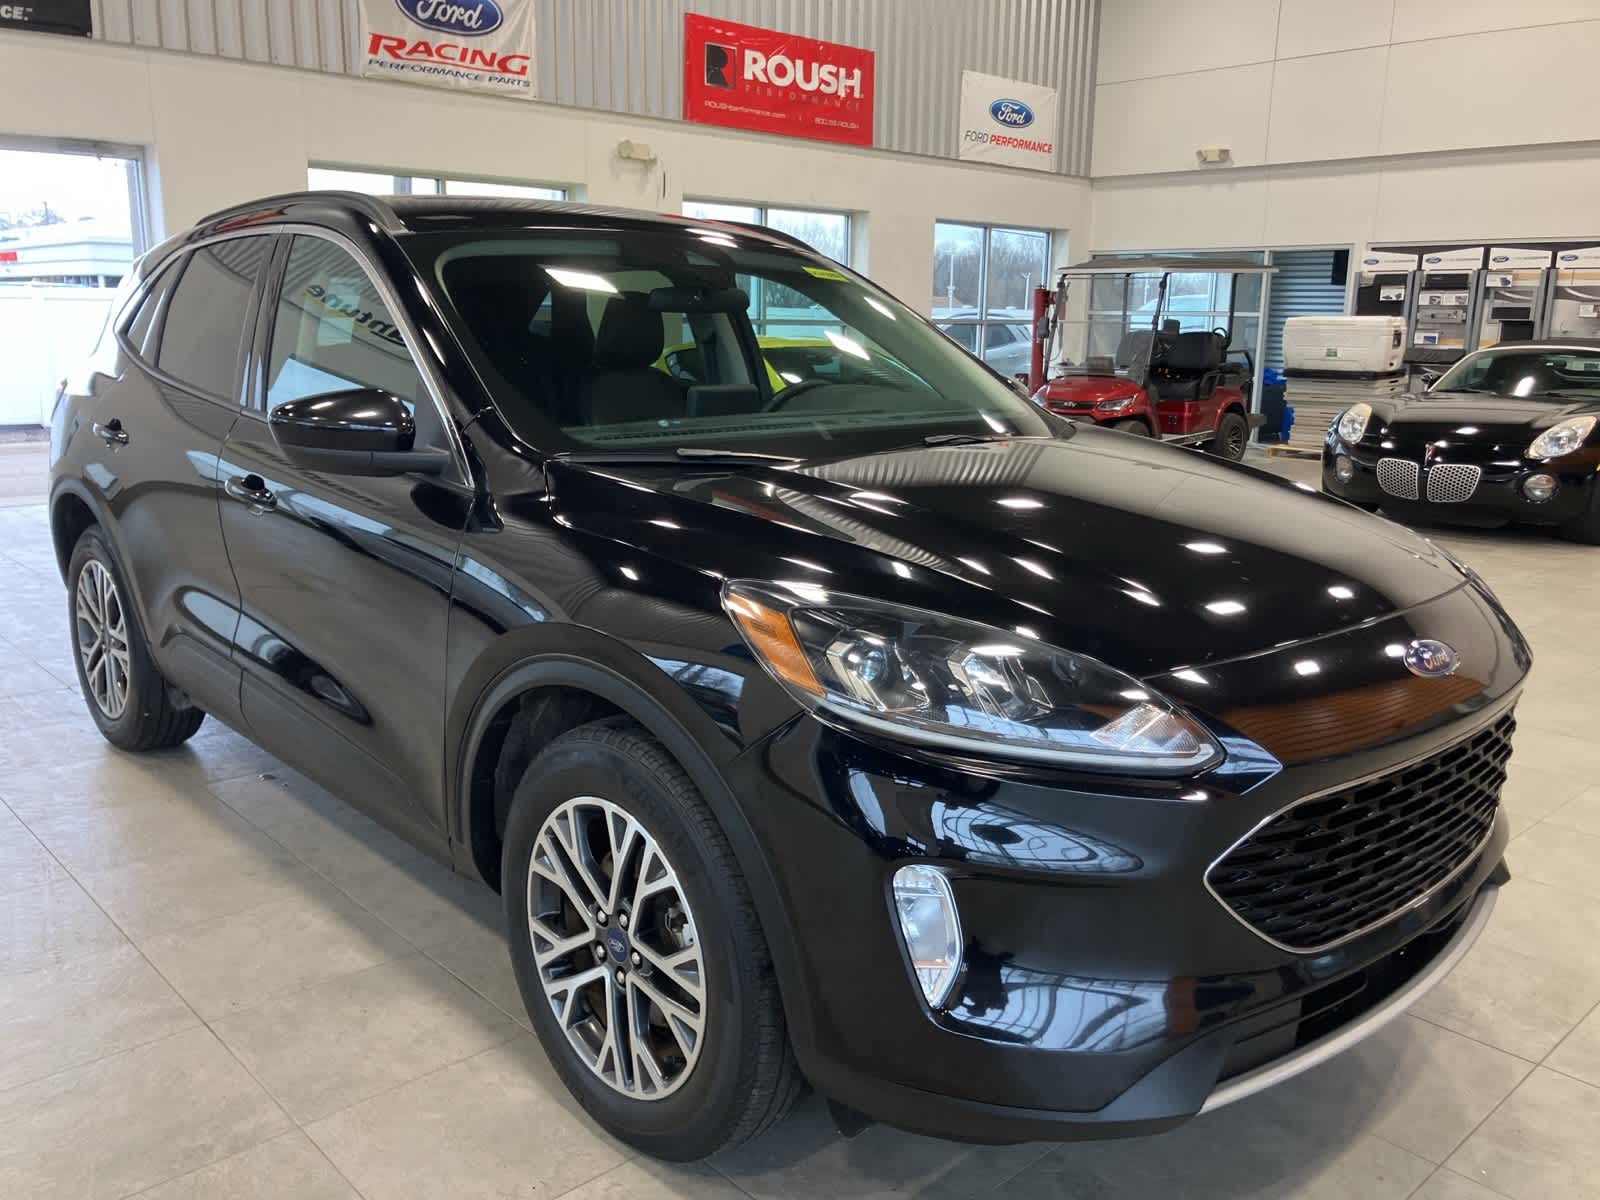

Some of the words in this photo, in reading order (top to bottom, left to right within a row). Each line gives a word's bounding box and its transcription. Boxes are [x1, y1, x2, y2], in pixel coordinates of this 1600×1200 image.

[368, 32, 531, 76] RACING
[368, 58, 482, 81] PERFORMANCE
[488, 75, 531, 88] PARTS
[743, 49, 862, 99] ROUSH
[998, 102, 1026, 124] Ford
[964, 129, 989, 143] FORD
[989, 134, 1053, 154] PERFORMANCE
